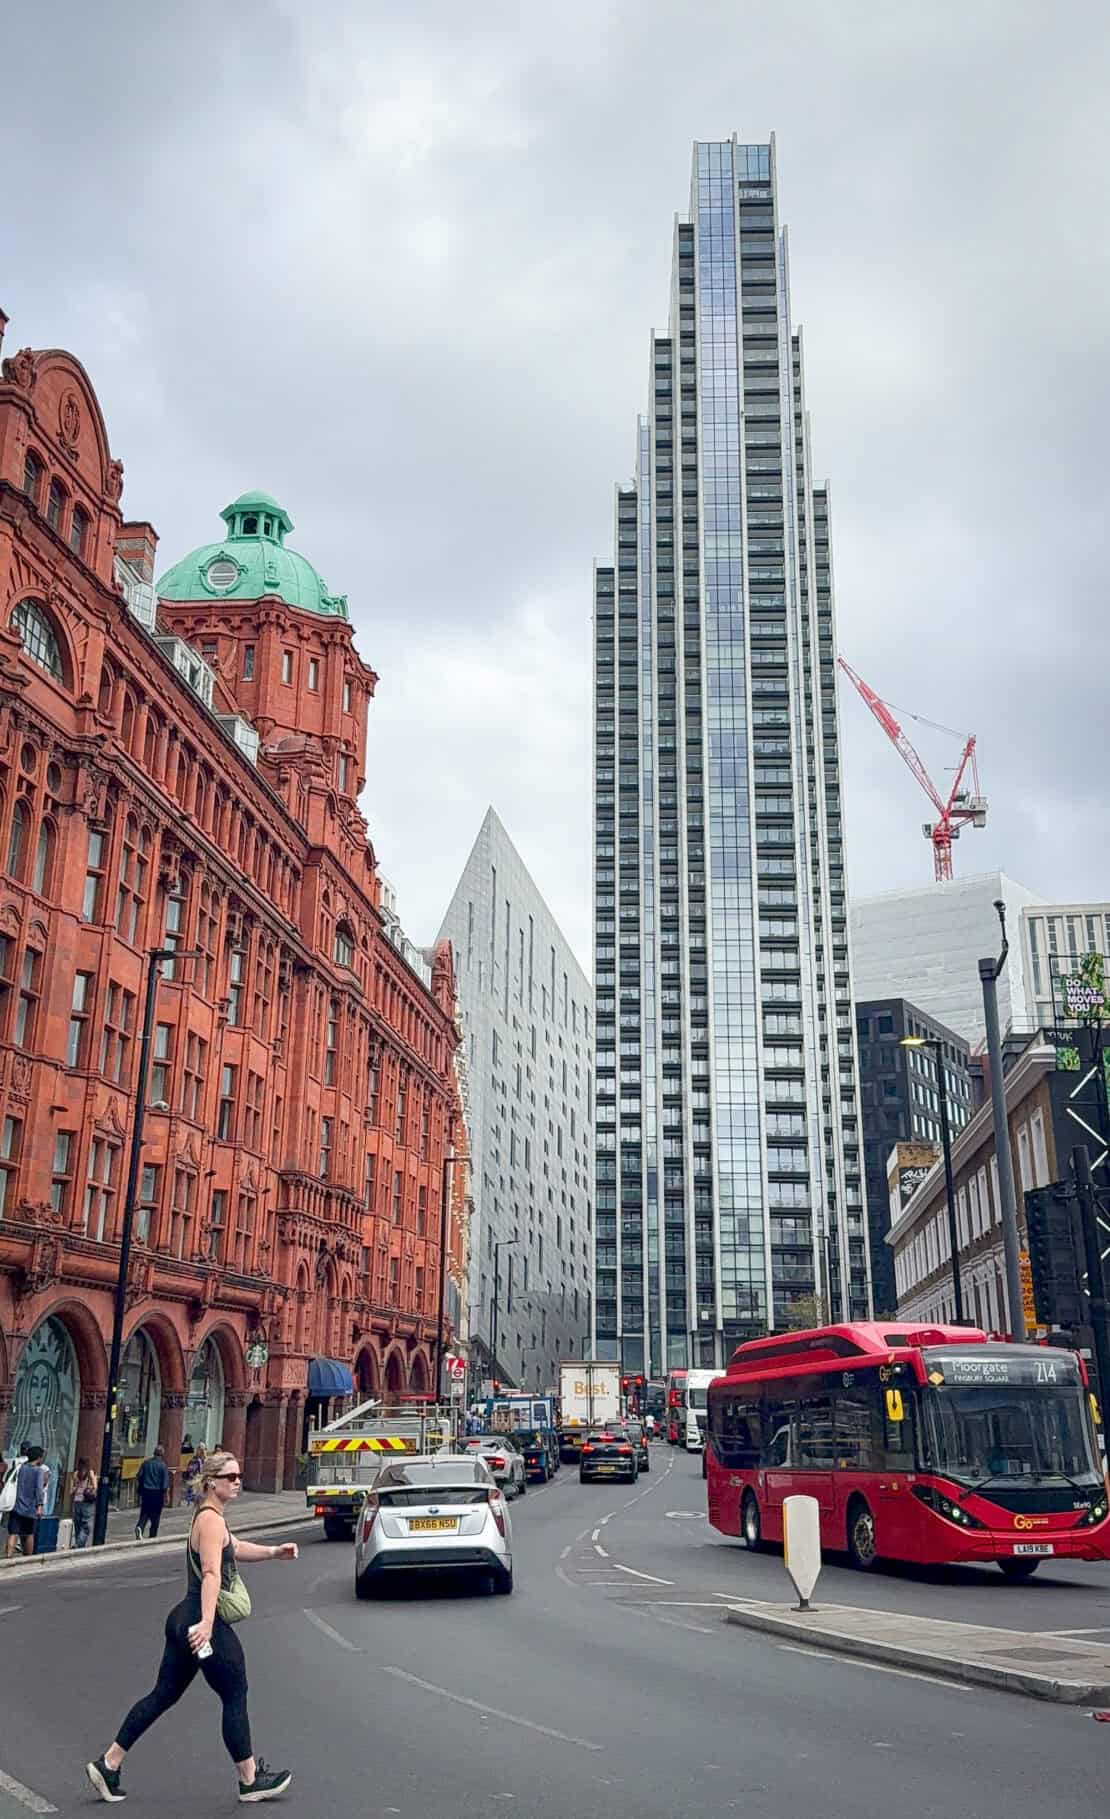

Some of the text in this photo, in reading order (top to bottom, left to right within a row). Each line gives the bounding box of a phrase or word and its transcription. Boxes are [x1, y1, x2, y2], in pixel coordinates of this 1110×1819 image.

[1066, 979, 1081, 987] DO
[1066, 987, 1097, 995] WHAT
[1067, 995, 1104, 1004] MOVES
[1068, 1003, 1090, 1012] YOU
[952, 1361, 1057, 1382] Moorgate 214
[414, 1519, 438, 1529] BX66
